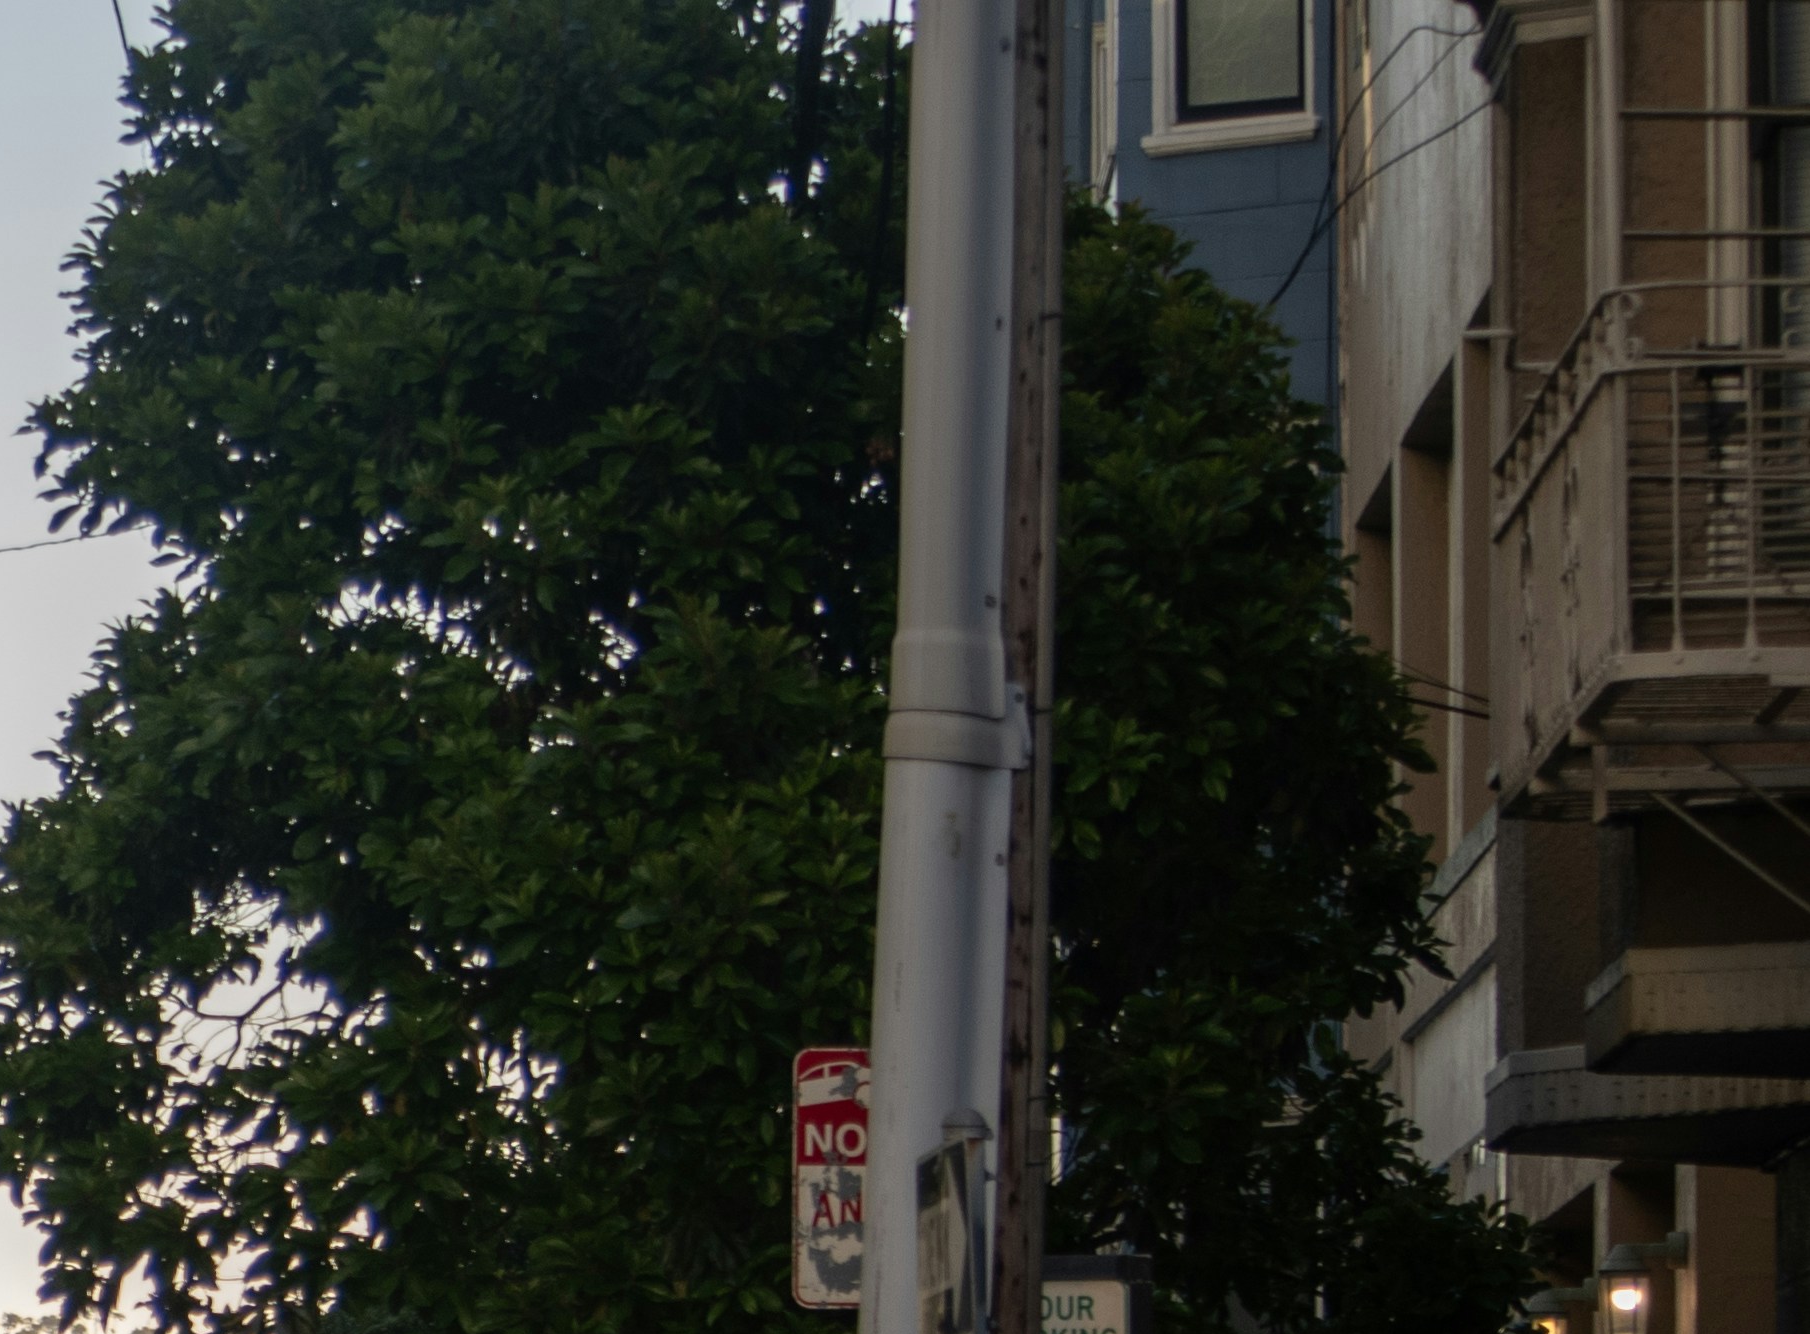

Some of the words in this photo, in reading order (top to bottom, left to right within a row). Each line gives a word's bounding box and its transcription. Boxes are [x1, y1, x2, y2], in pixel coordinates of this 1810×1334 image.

[804, 1121, 868, 1158] NO
[813, 1190, 862, 1228] AN
[1040, 1295, 1094, 1321] OUR
